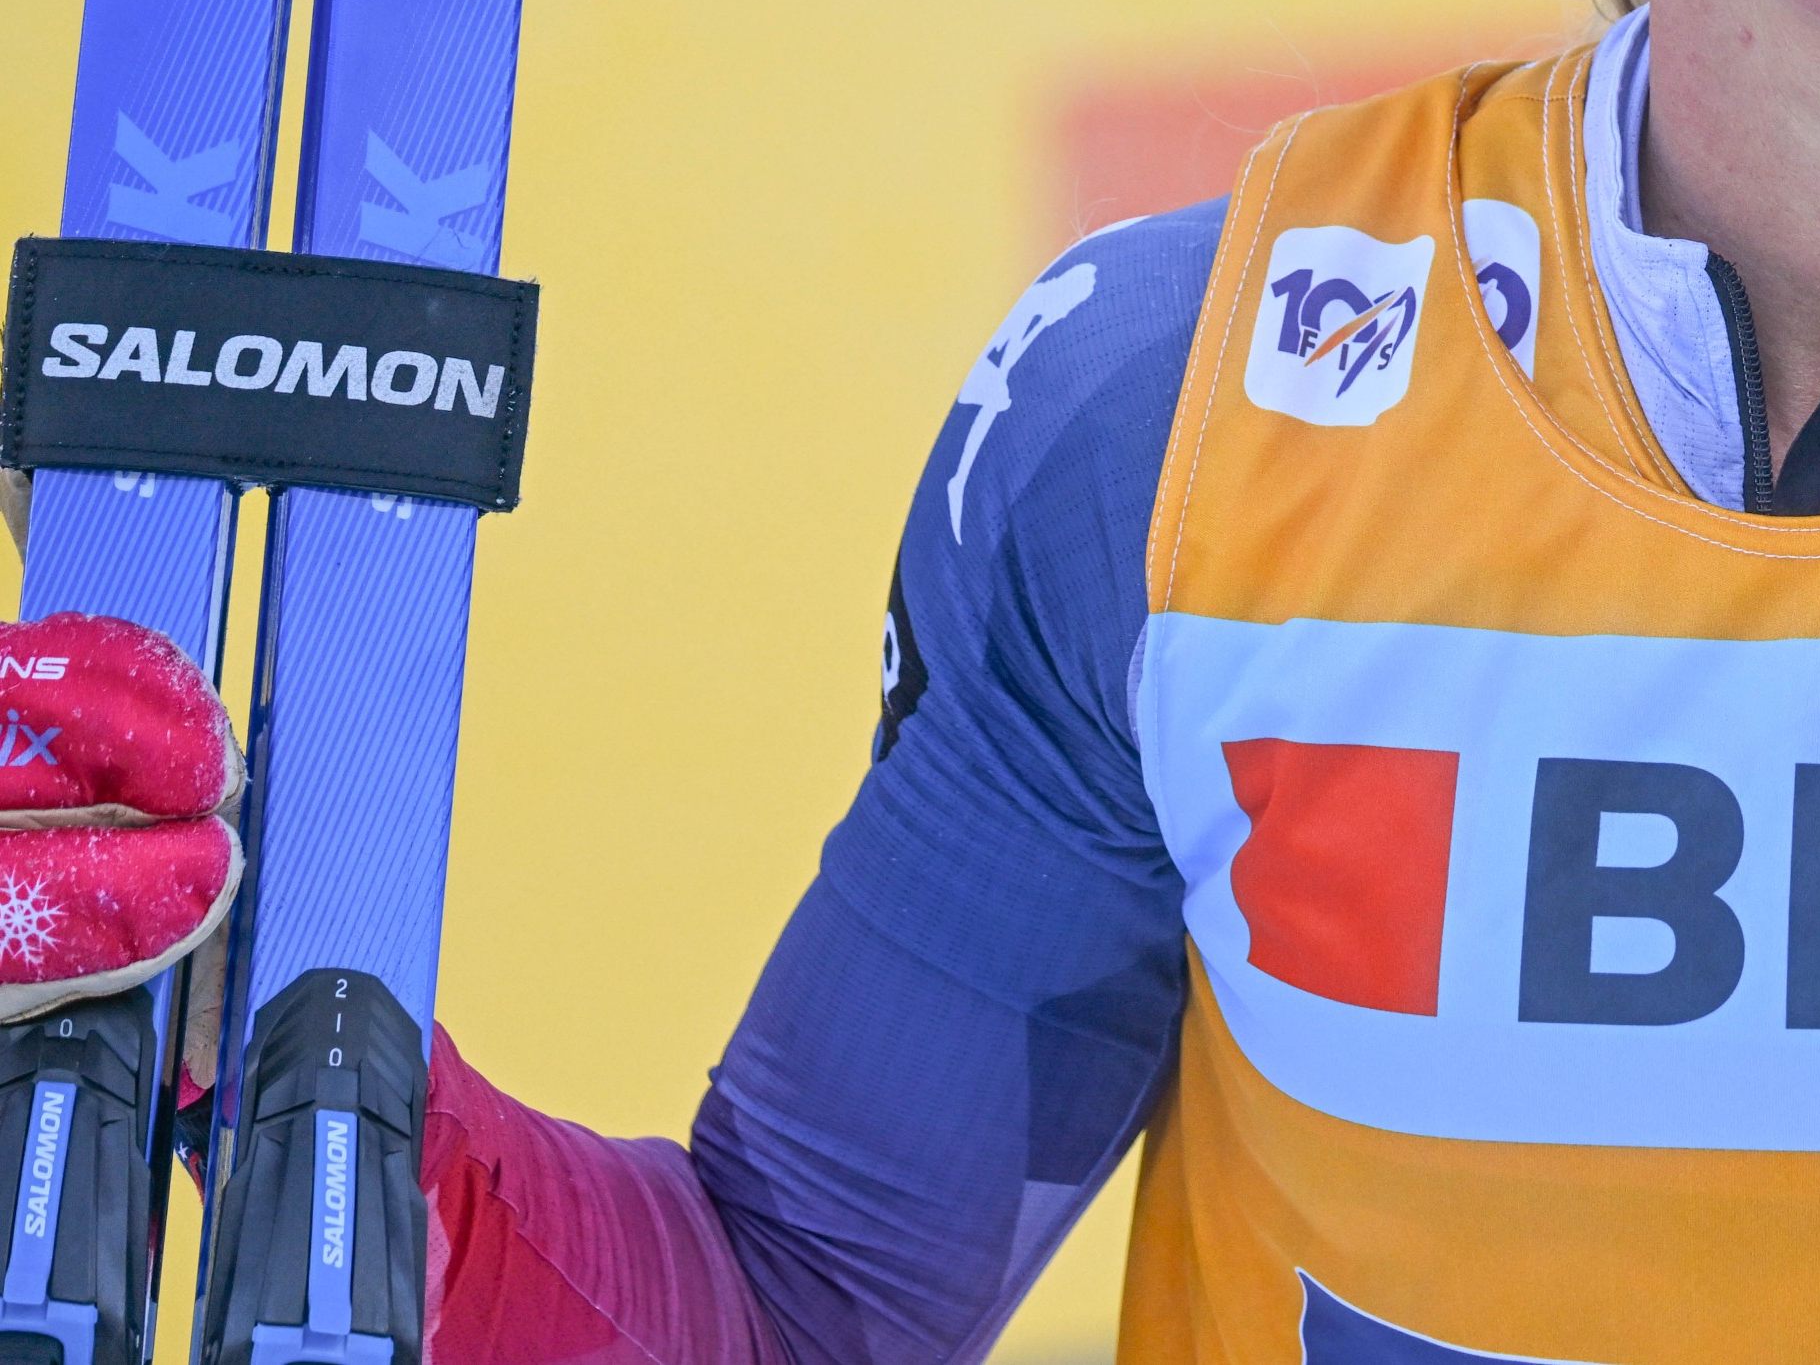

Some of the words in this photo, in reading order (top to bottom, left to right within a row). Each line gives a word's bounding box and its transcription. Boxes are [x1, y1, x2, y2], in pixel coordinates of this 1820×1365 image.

[41, 322, 505, 418] SALOMON
[336, 978, 348, 1000] 2
[24, 1091, 65, 1239] SALOMON
[322, 1120, 349, 1268] SALOMON
